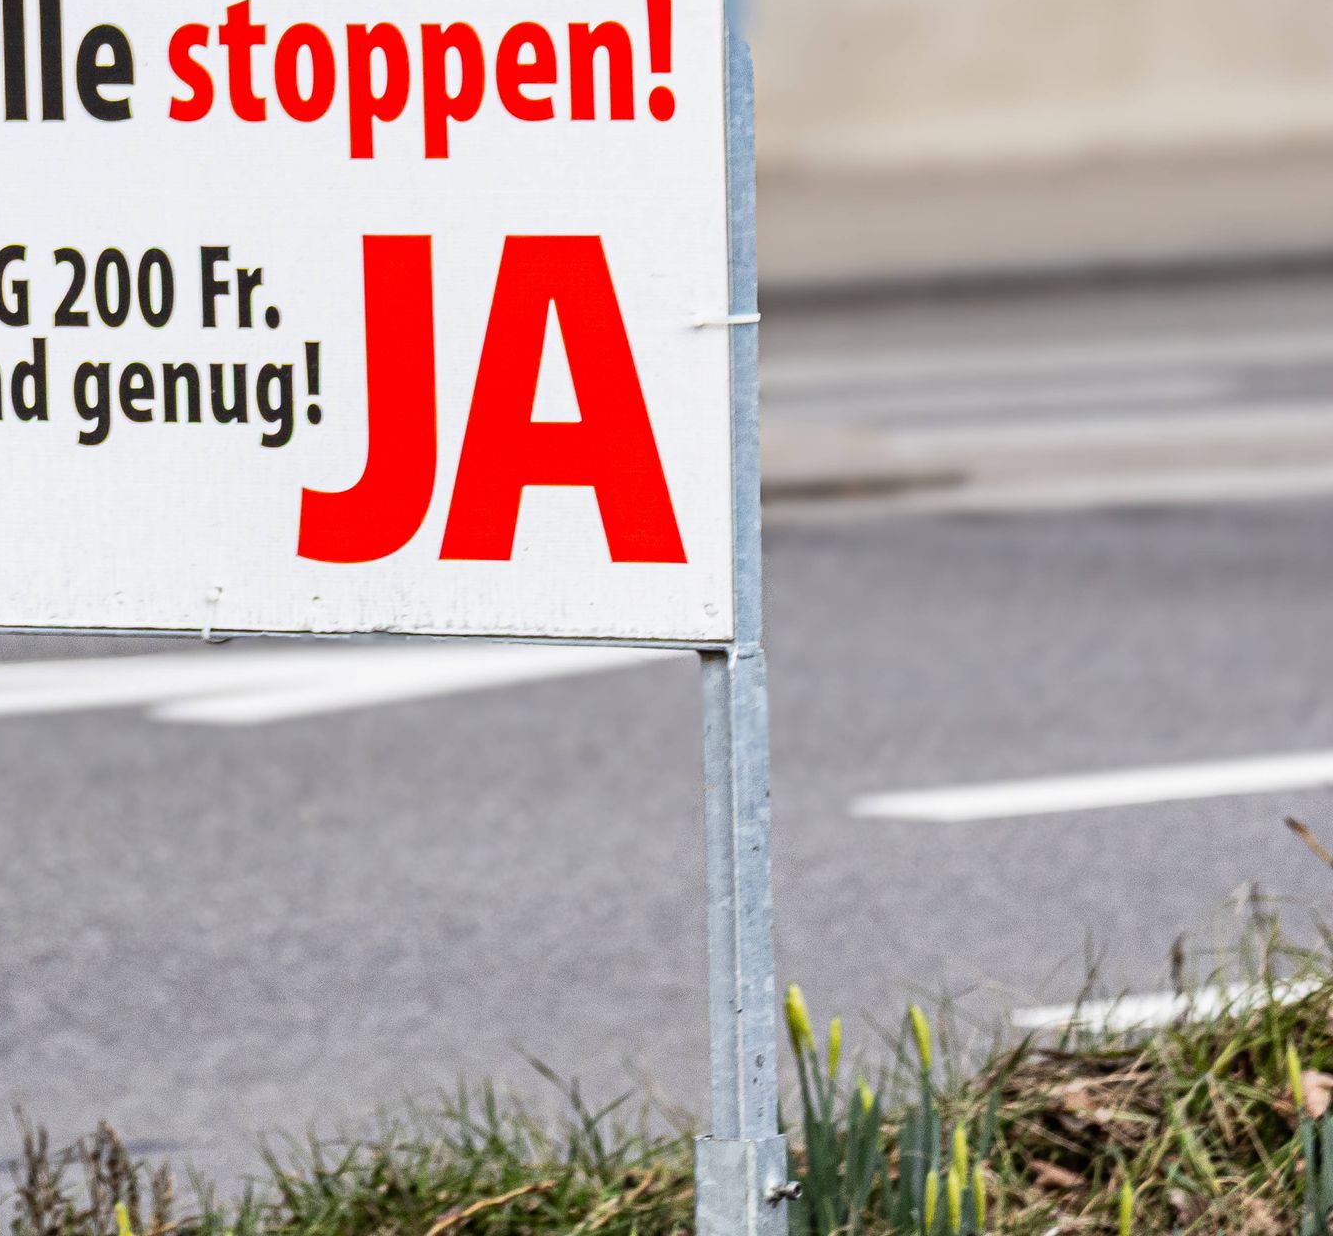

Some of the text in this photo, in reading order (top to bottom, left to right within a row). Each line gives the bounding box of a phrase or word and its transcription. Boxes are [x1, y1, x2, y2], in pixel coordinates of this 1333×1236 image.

[53, 247, 174, 329] 200
[200, 246, 281, 330] Fr.
[73, 341, 322, 448] genug!
[296, 234, 689, 565] JA
